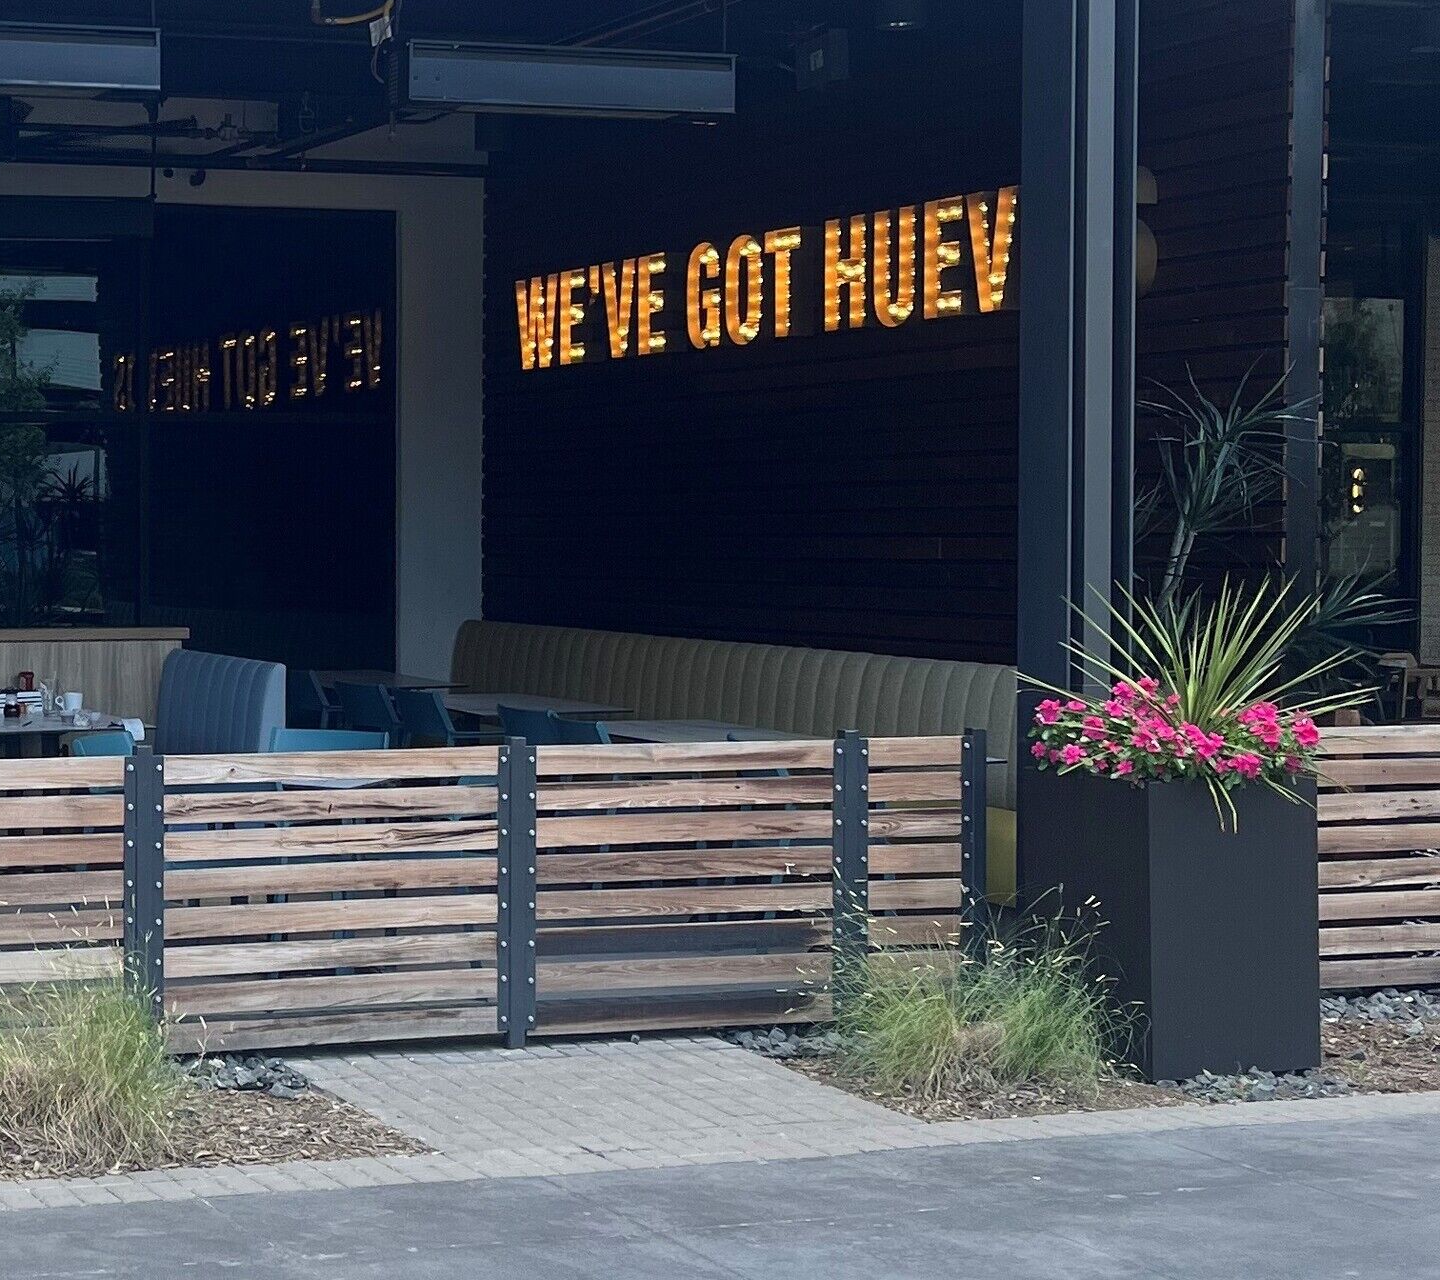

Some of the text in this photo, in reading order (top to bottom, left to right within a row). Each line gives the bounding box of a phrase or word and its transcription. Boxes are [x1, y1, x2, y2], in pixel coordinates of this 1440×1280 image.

[515, 185, 1019, 370] WE'VE GOT HUEV
